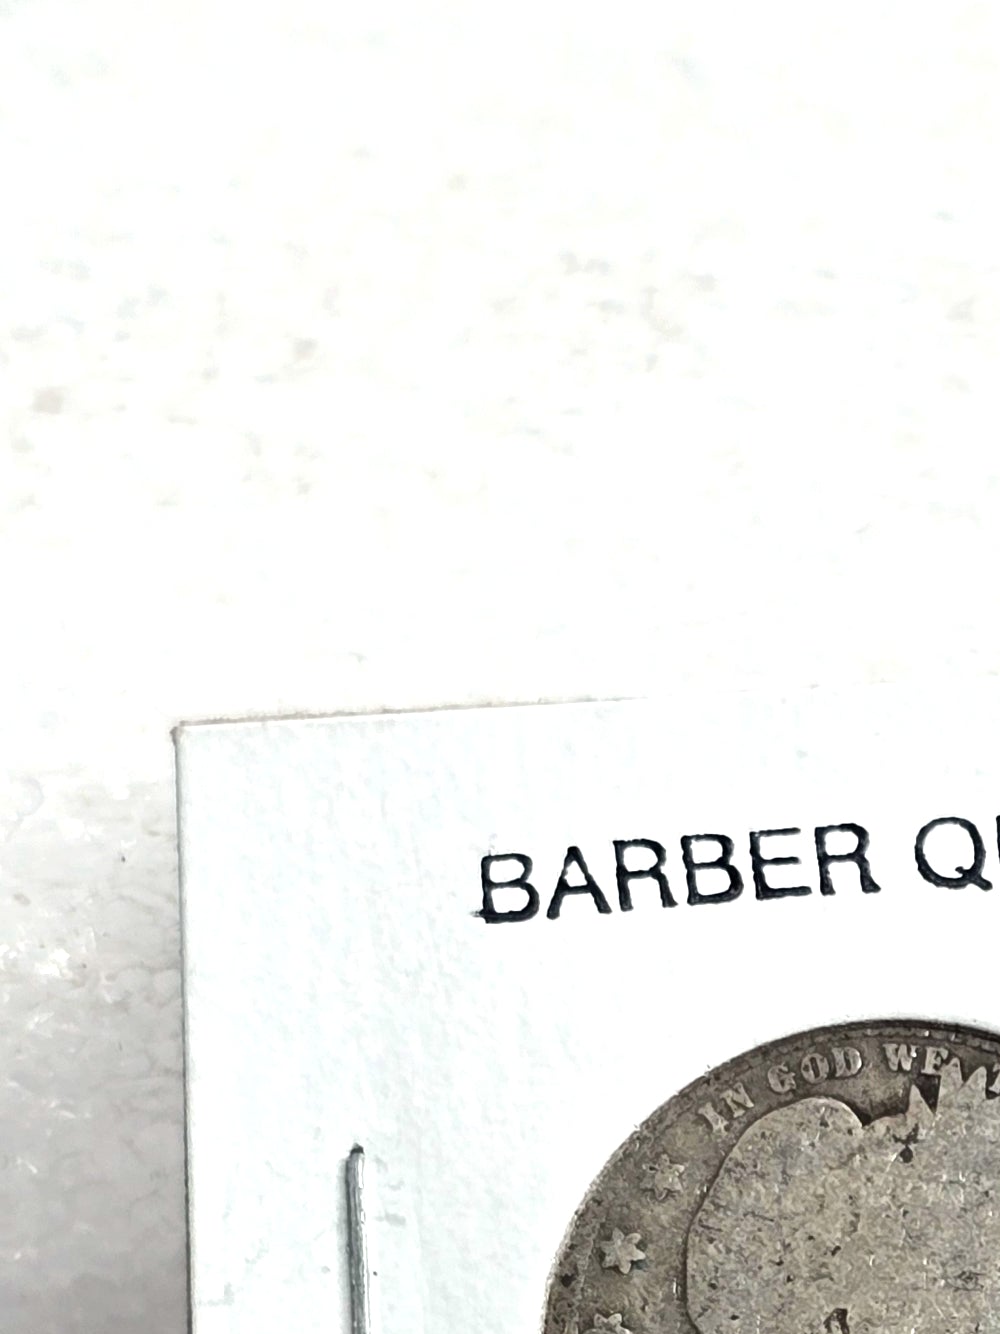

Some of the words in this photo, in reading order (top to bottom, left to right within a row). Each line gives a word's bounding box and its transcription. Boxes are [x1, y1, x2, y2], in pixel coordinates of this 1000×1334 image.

[478, 822, 881, 924] BARBER
[700, 1081, 756, 1134] IN
[767, 1046, 864, 1094] GOD
